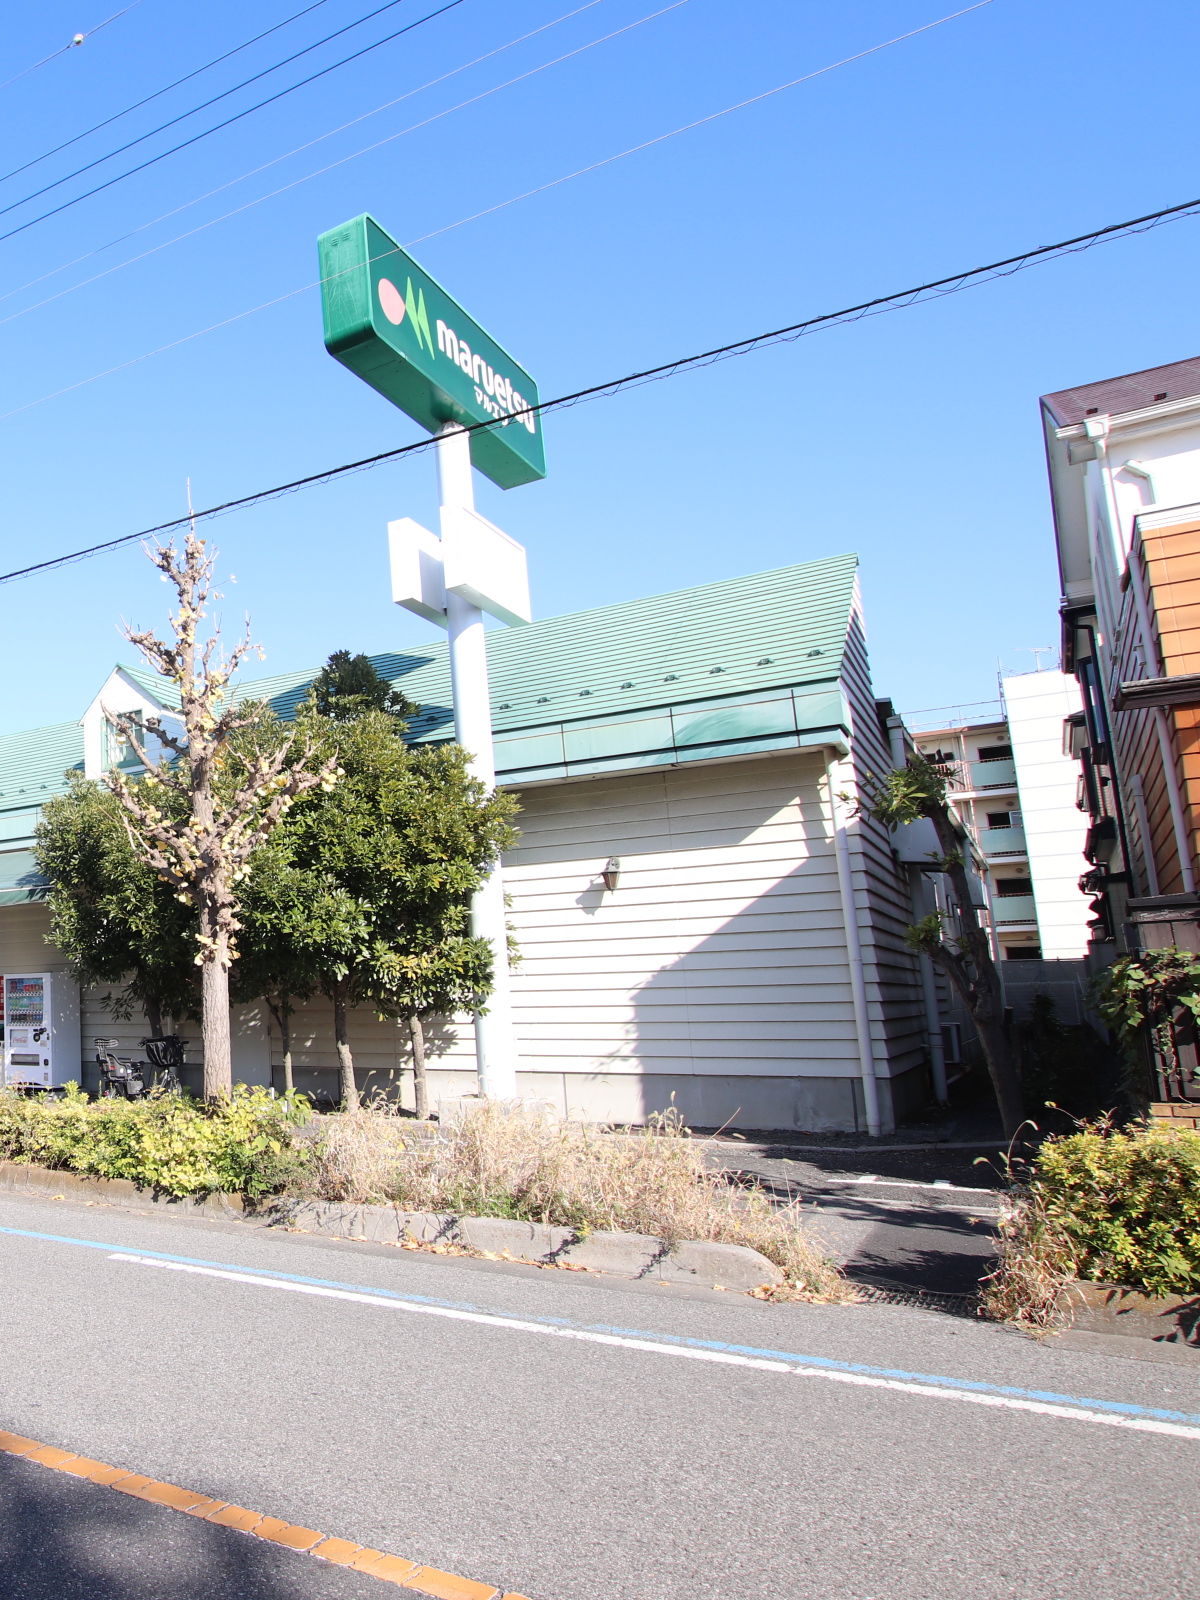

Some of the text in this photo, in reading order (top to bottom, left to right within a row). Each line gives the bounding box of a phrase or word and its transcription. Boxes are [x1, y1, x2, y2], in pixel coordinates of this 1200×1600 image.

[436, 319, 535, 434] maruetsu
[473, 385, 509, 426] マルエツ
